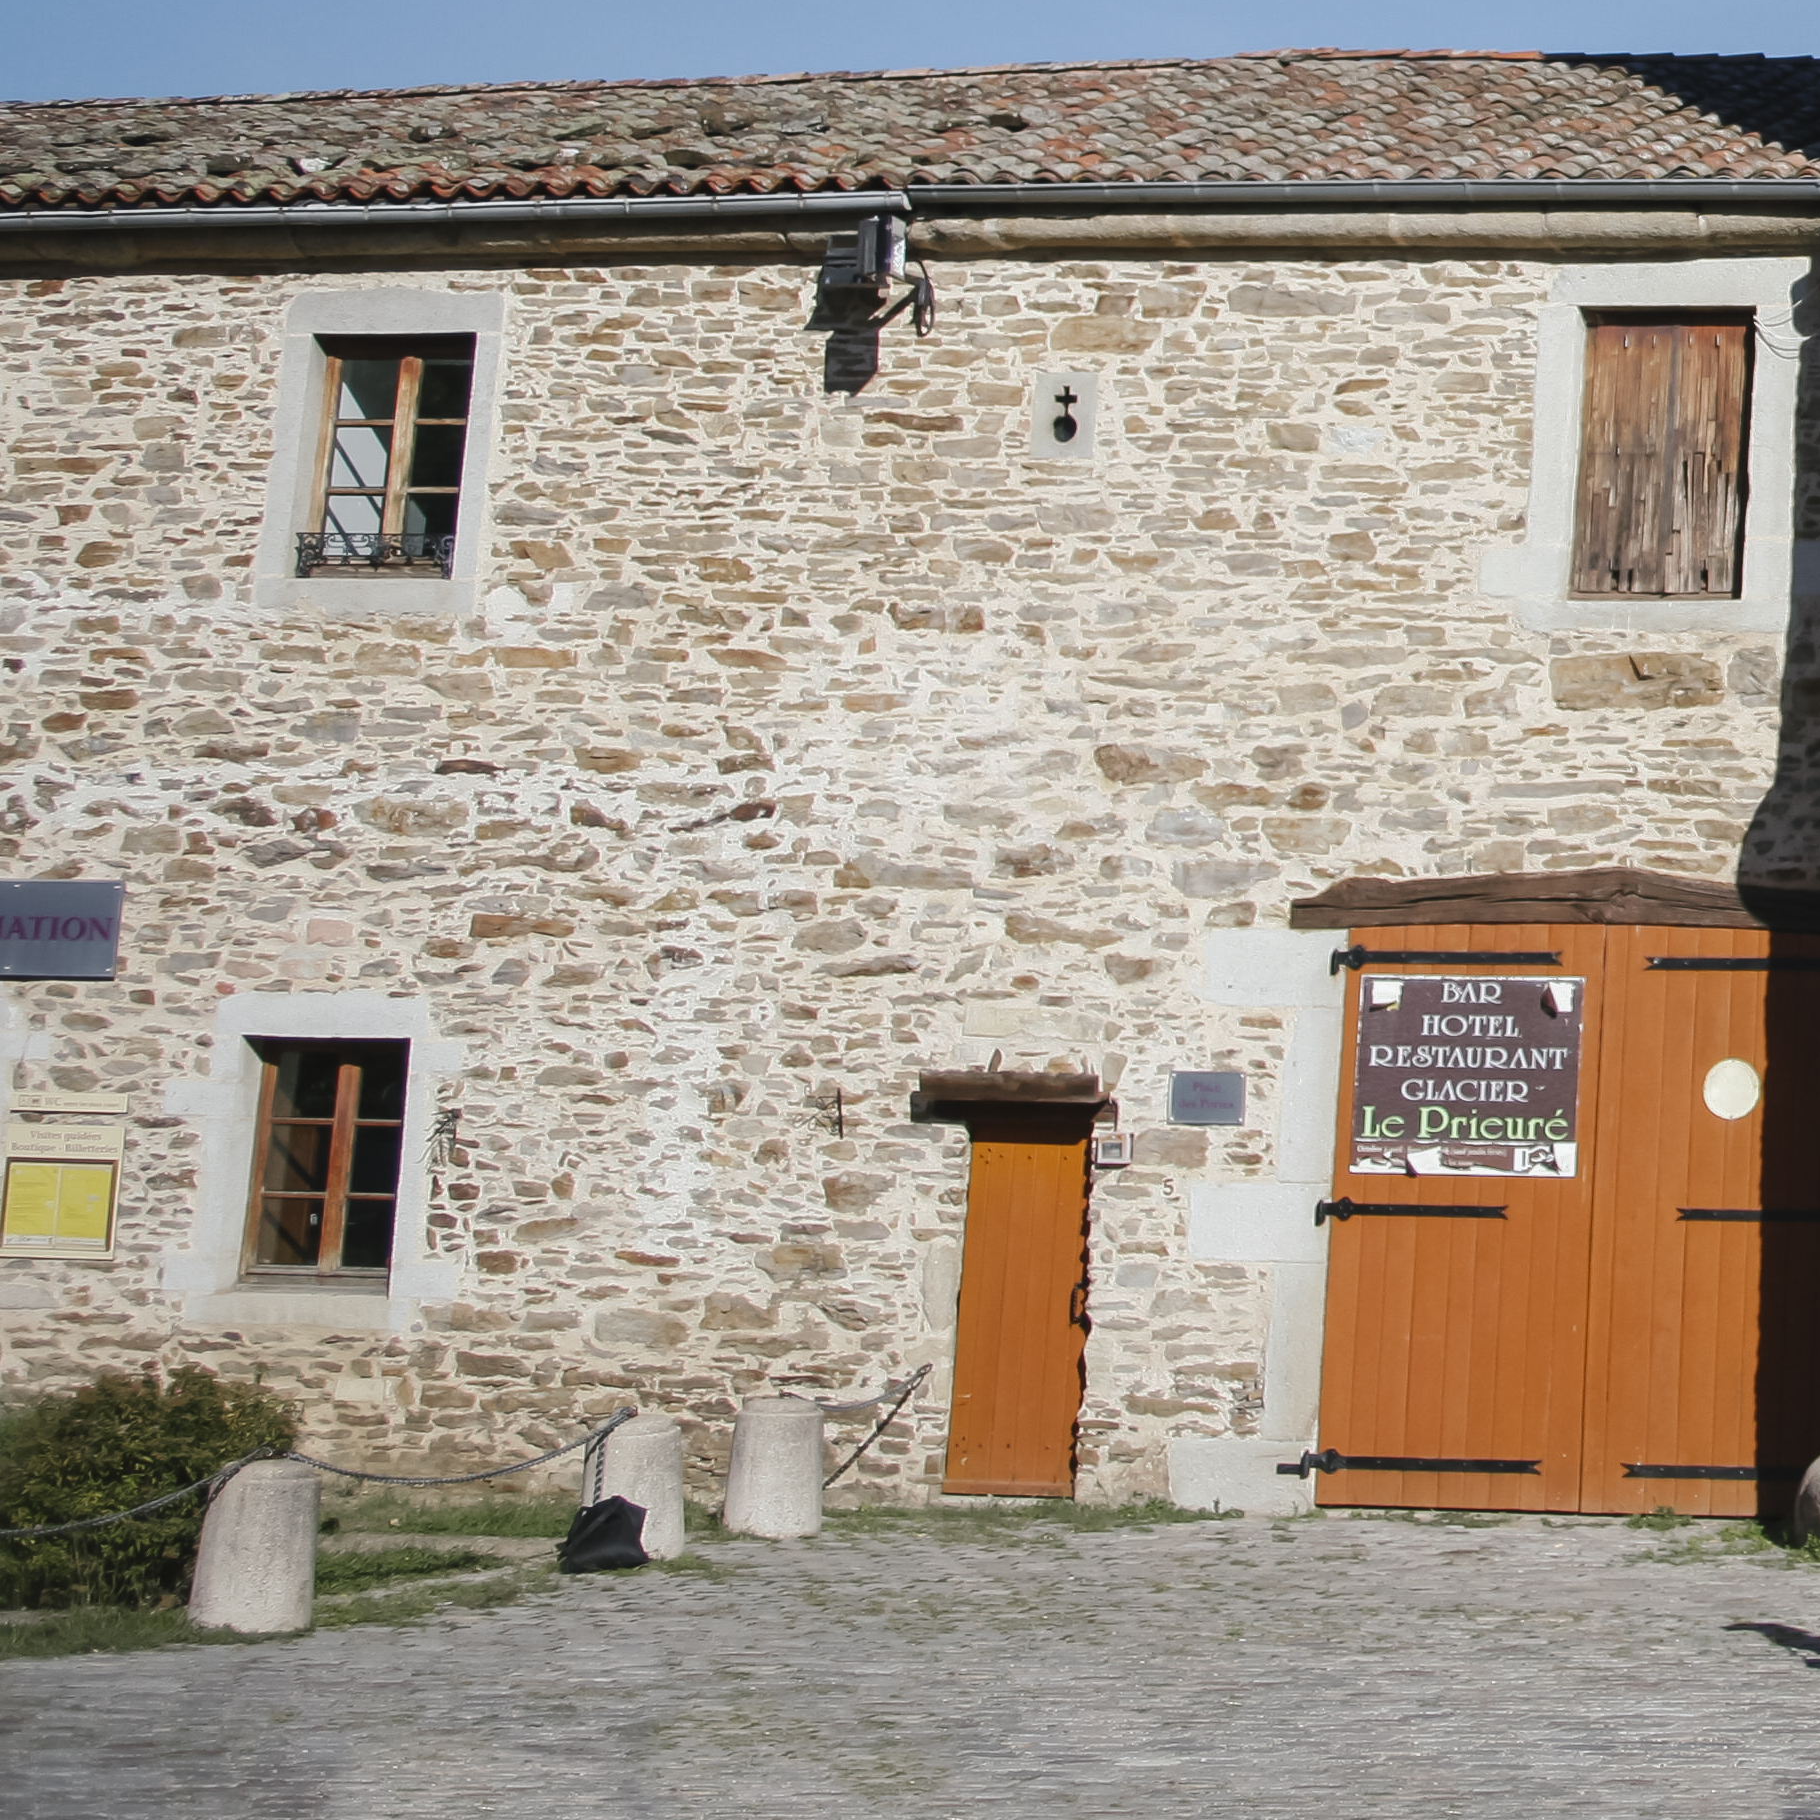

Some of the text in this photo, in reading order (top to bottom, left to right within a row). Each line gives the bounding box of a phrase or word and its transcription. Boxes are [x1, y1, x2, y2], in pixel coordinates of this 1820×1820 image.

[1440, 981, 1503, 1005] BAR
[1420, 1014, 1520, 1038] HOTEL
[1368, 1044, 1569, 1071] RESTAURANT
[1401, 1078, 1530, 1103] GLACIER
[1360, 1105, 1570, 1141] Le Prieuré
[11, 1142, 56, 1154] Boutique
[30, 1131, 102, 1142] Visites guidées
